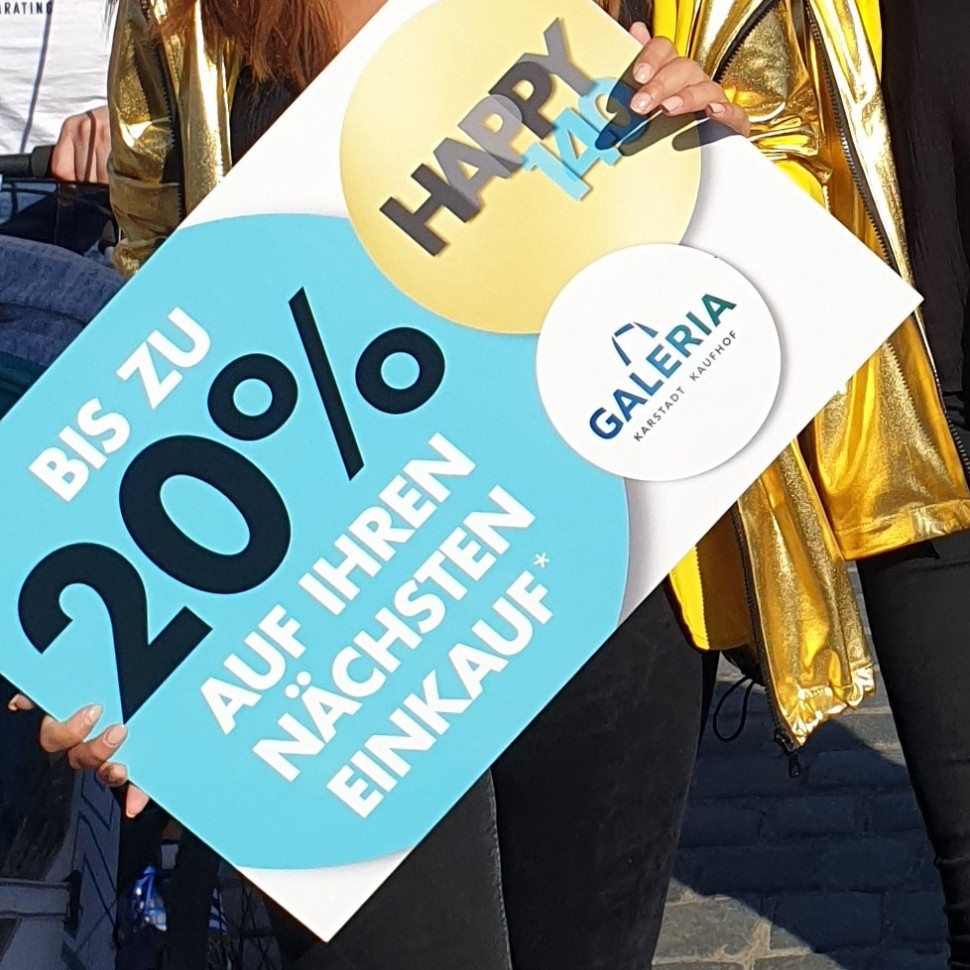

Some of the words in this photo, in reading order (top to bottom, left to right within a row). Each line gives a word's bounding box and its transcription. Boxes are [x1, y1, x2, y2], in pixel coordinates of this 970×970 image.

[379, 17, 600, 257] HAPPY
[29, 397, 131, 502] BIS
[116, 307, 211, 409] ZU
[589, 293, 738, 440] GALERIA
[633, 386, 685, 442] KARSTADT
[689, 329, 738, 382] KAUFHOF
[17, 286, 446, 726] 20%
[200, 604, 307, 734] AUF
[299, 432, 476, 616] IHREN
[252, 485, 536, 782] NÄCHSTEN
